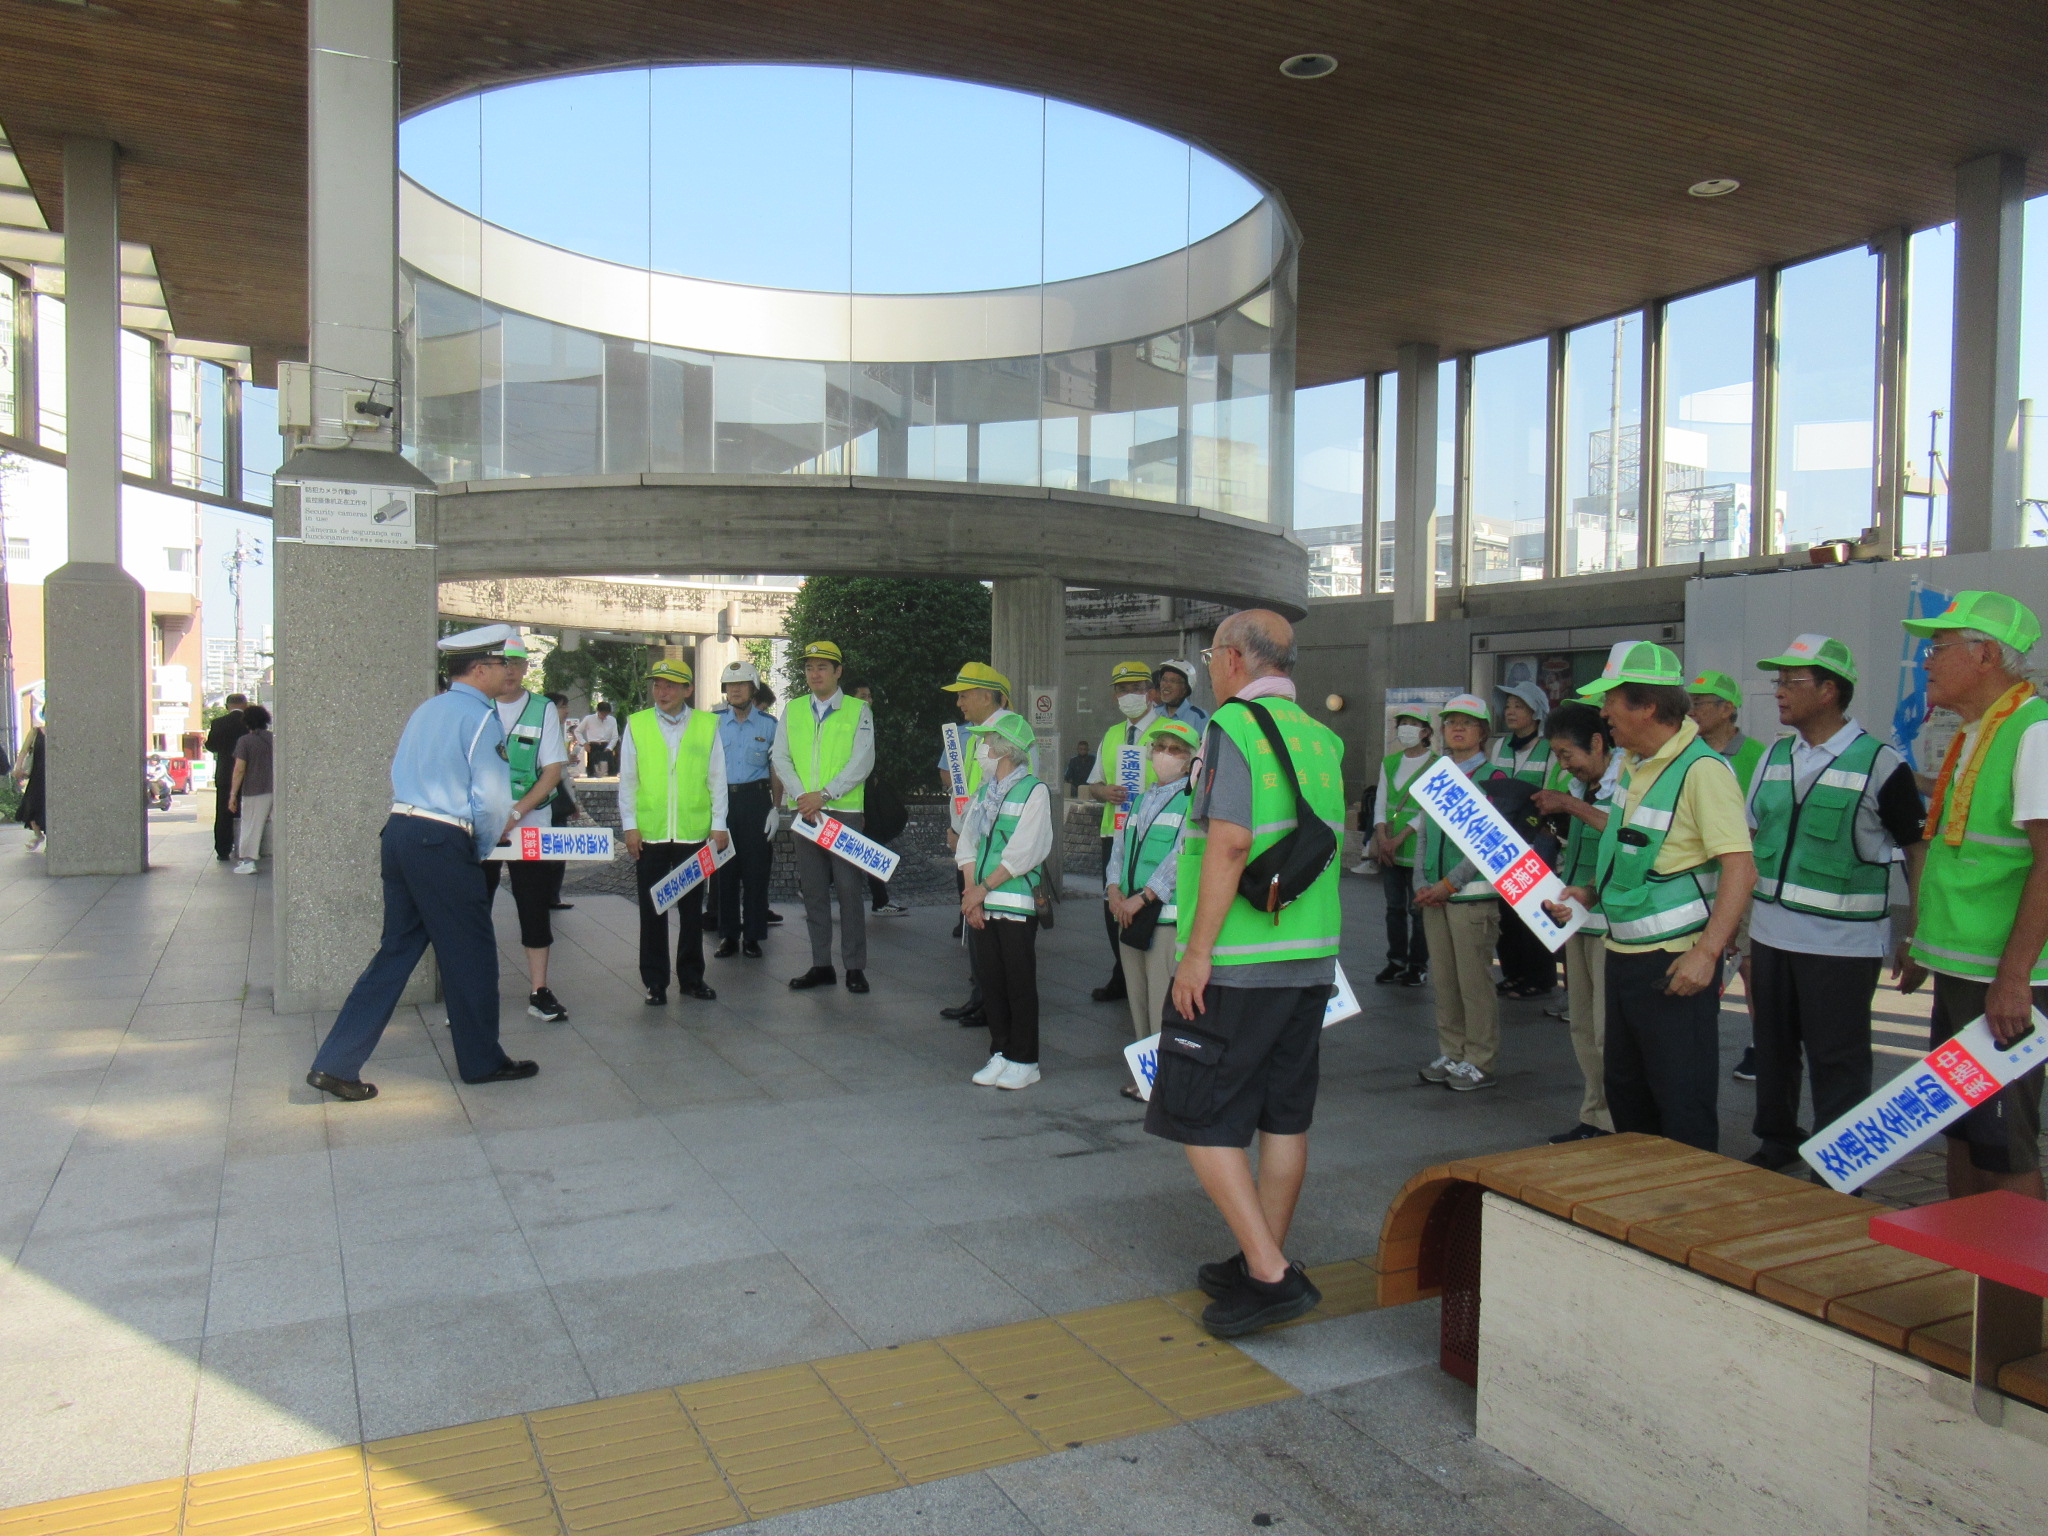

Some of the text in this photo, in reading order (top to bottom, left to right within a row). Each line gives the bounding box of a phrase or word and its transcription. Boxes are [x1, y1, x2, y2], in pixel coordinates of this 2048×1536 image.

[305, 507, 368, 518] Security cameras
[305, 533, 359, 542] funcionamento
[945, 728, 966, 796] 交通安全運動
[541, 833, 609, 855] 交通安全運動
[1422, 768, 1520, 875] 交通安全運動
[834, 829, 892, 875] 交通安全運動
[1500, 857, 1541, 900] 実施中
[1936, 1050, 1994, 1099] 実施中
[1816, 1073, 1958, 1181] 交通安全運動
